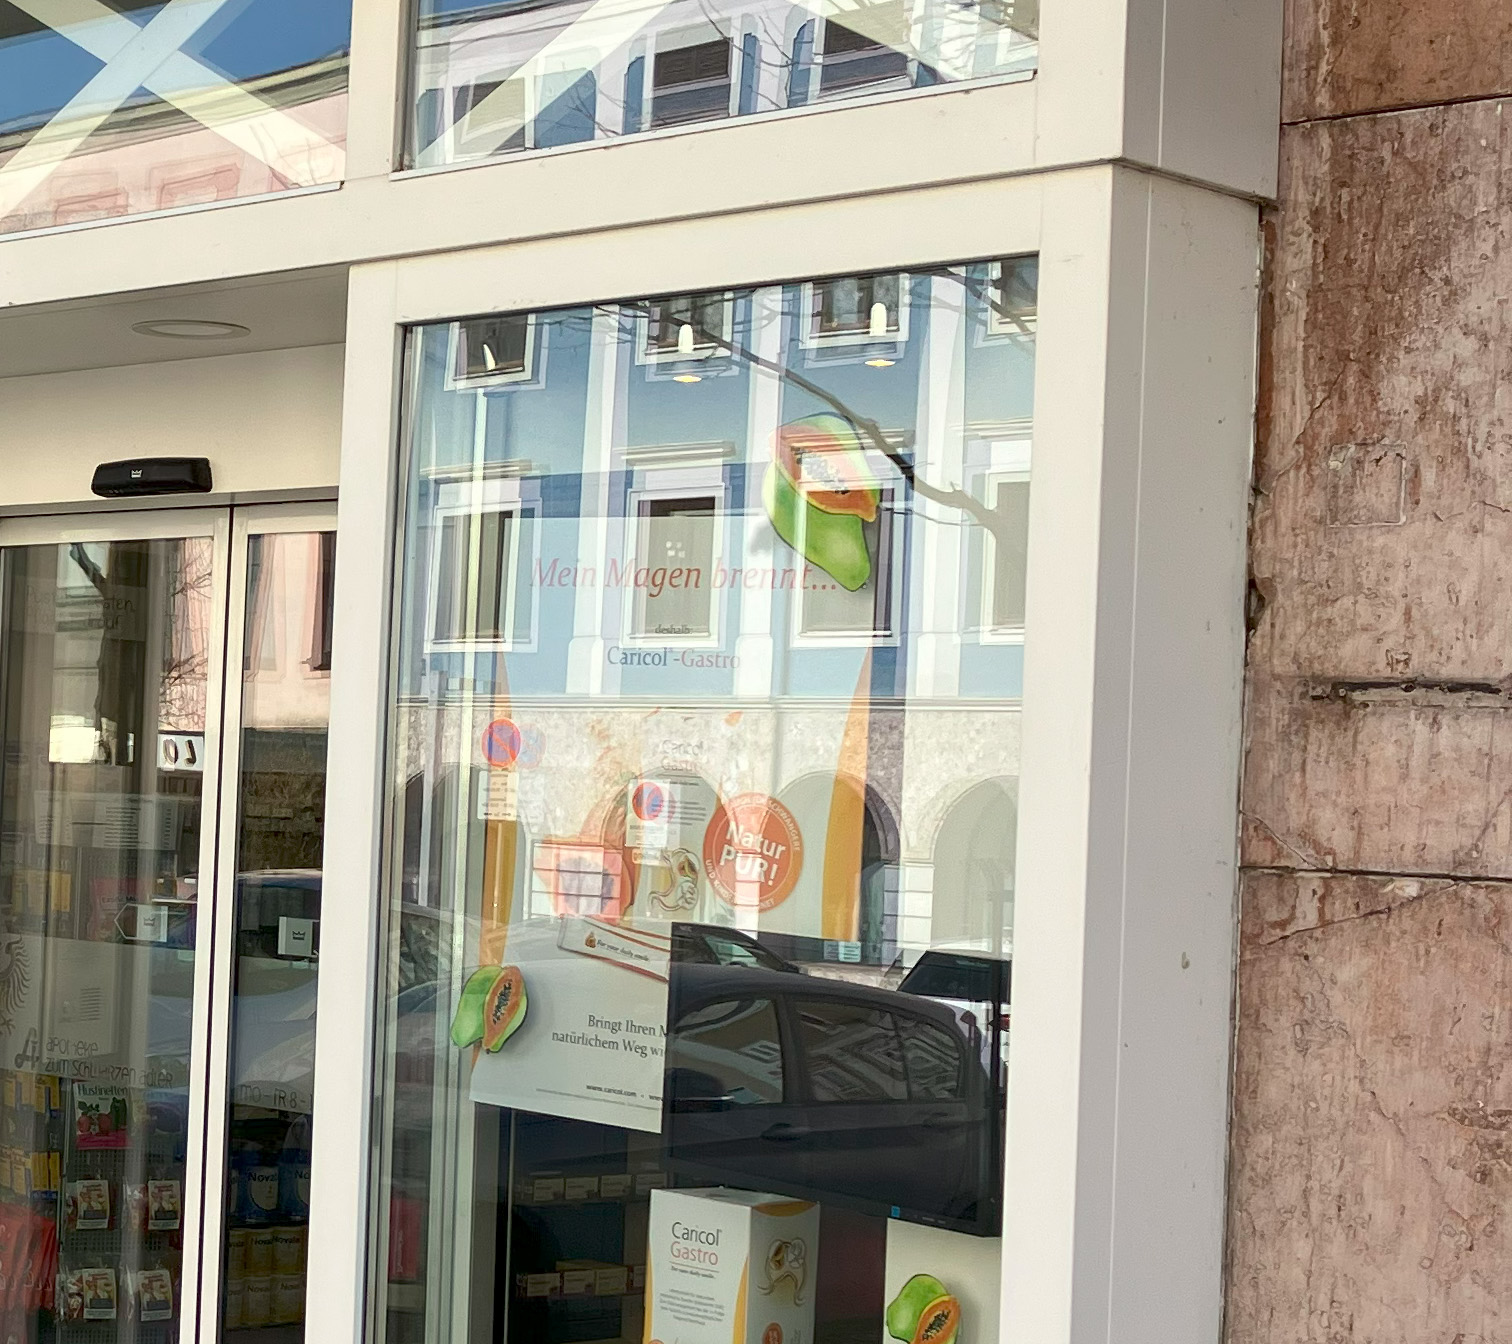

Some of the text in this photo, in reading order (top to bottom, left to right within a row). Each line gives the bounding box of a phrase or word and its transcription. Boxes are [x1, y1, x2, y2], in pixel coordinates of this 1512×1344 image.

[530, 557, 596, 588] Mein
[604, 557, 702, 598] Magen
[726, 821, 786, 860] Natur
[720, 844, 779, 887] PUR!
[588, 1014, 622, 1035] Bringt
[625, 1019, 656, 1036] Ihren
[551, 1031, 619, 1051] natürlichem
[622, 1038, 648, 1058] Weg
[670, 1240, 719, 1266] Gastro
